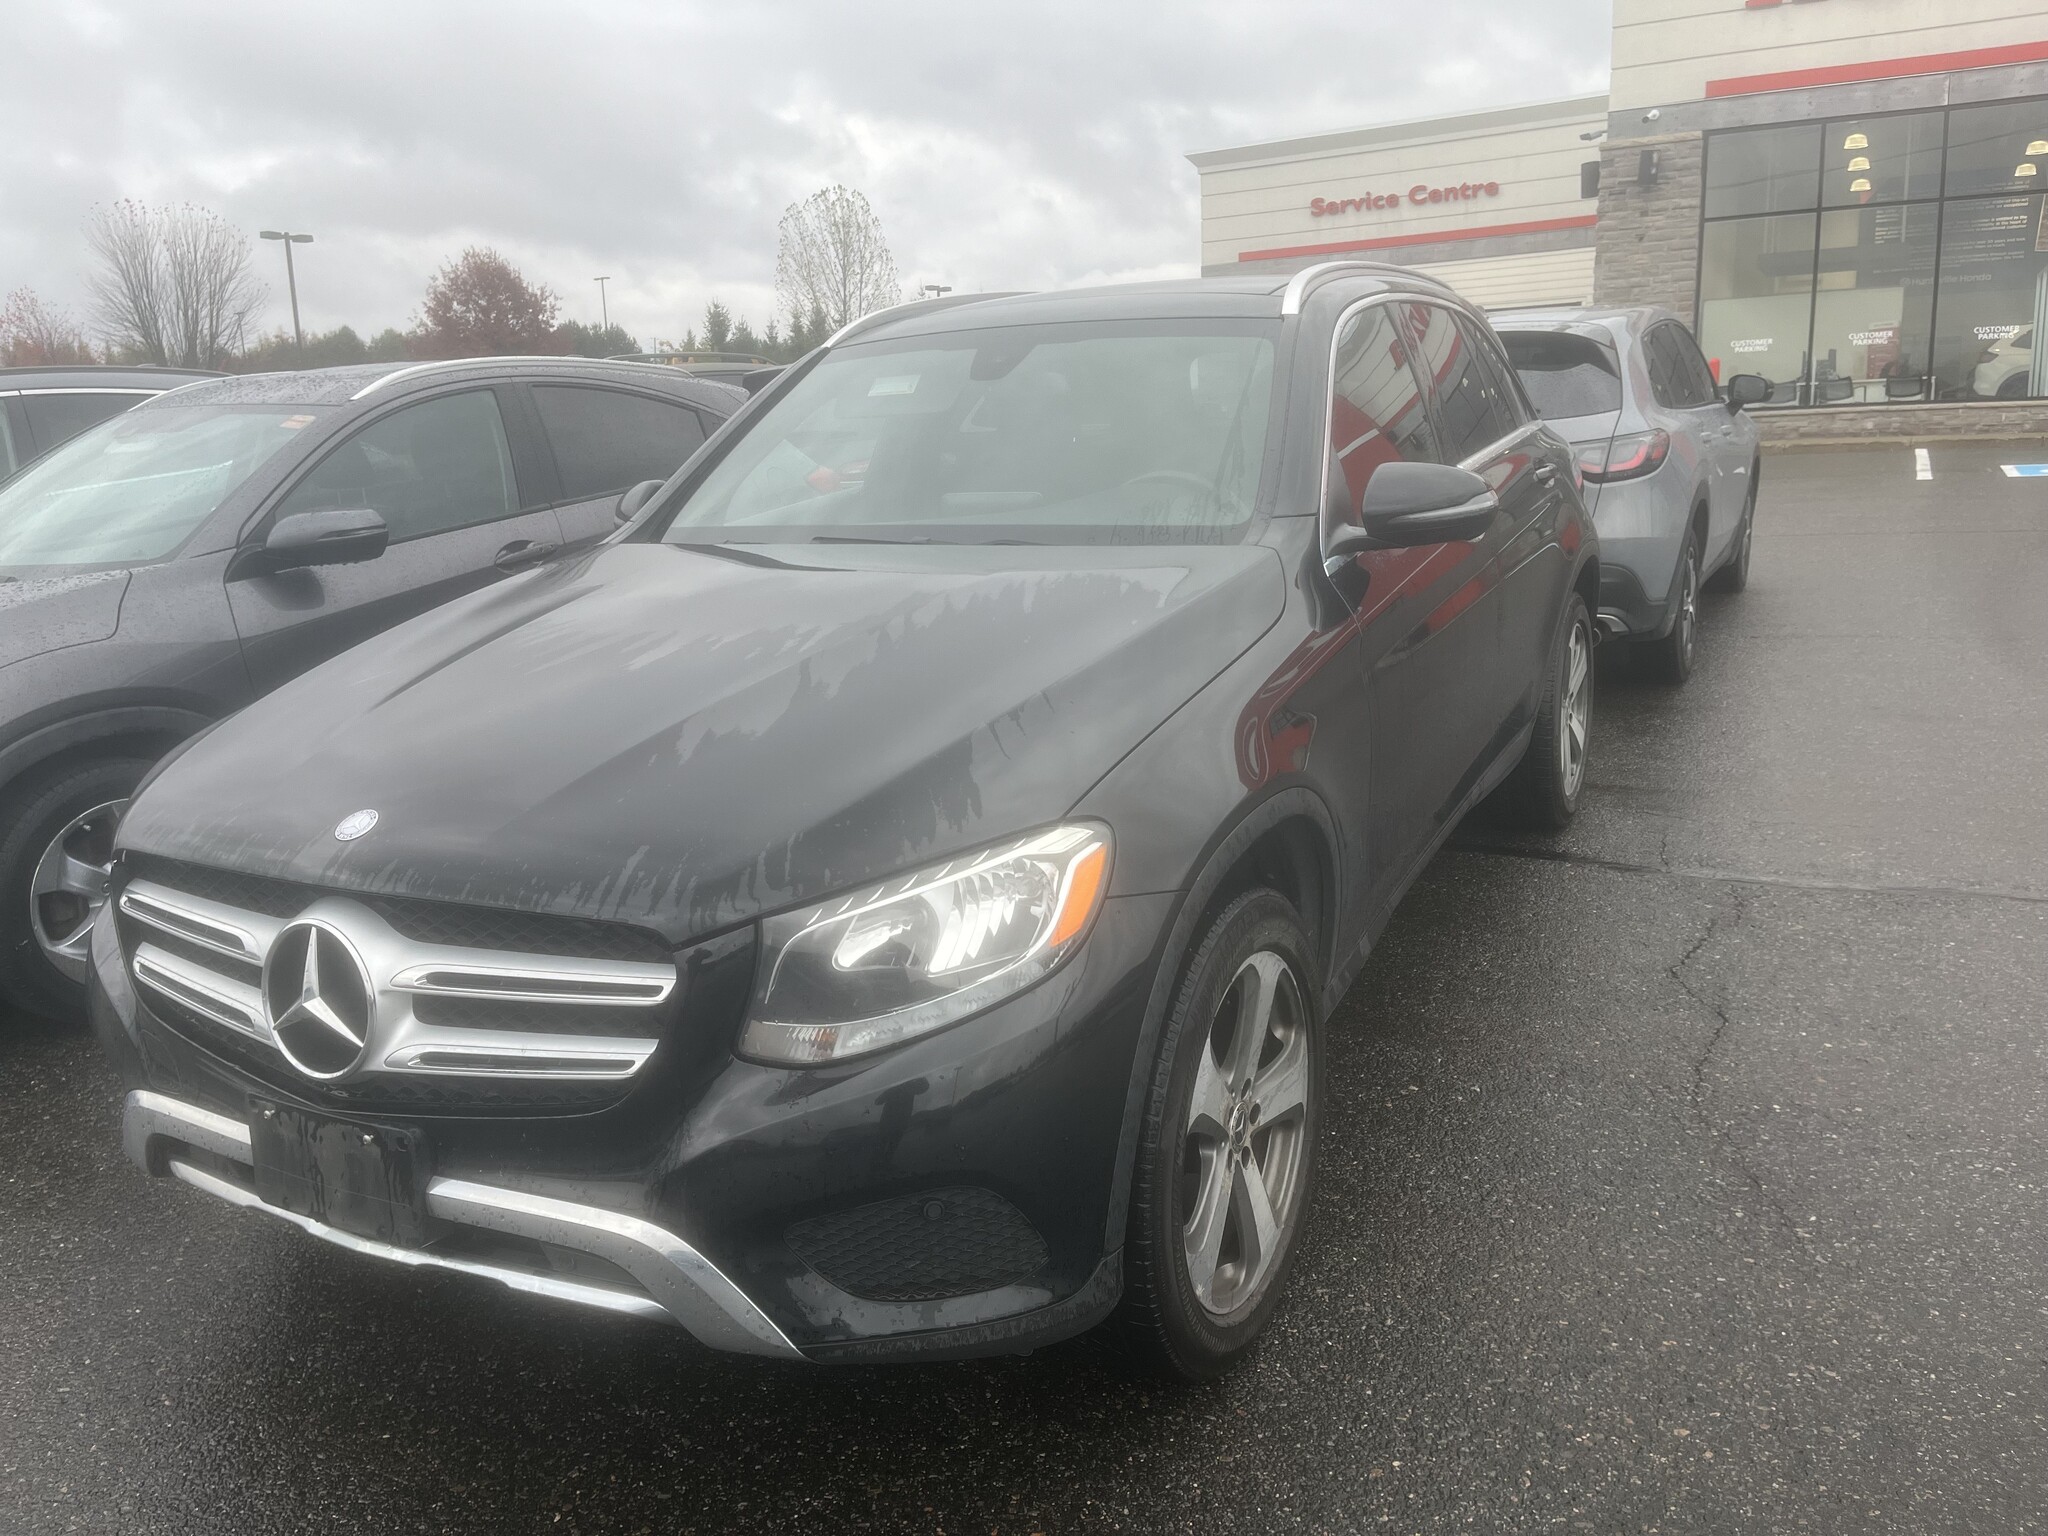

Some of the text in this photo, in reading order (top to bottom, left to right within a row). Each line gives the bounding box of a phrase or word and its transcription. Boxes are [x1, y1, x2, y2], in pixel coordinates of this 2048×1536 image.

[1310, 181, 1500, 217] Service Centre
[1960, 273, 1992, 282] Honda
[1973, 325, 2020, 334] CUSTOMER
[1848, 330, 1893, 340] CUSTOMER
[1978, 332, 2014, 340] PARKING
[1730, 338, 1773, 347] CUSTOMER
[1852, 338, 1888, 346] PARKING
[1734, 345, 1768, 353] PARKING
